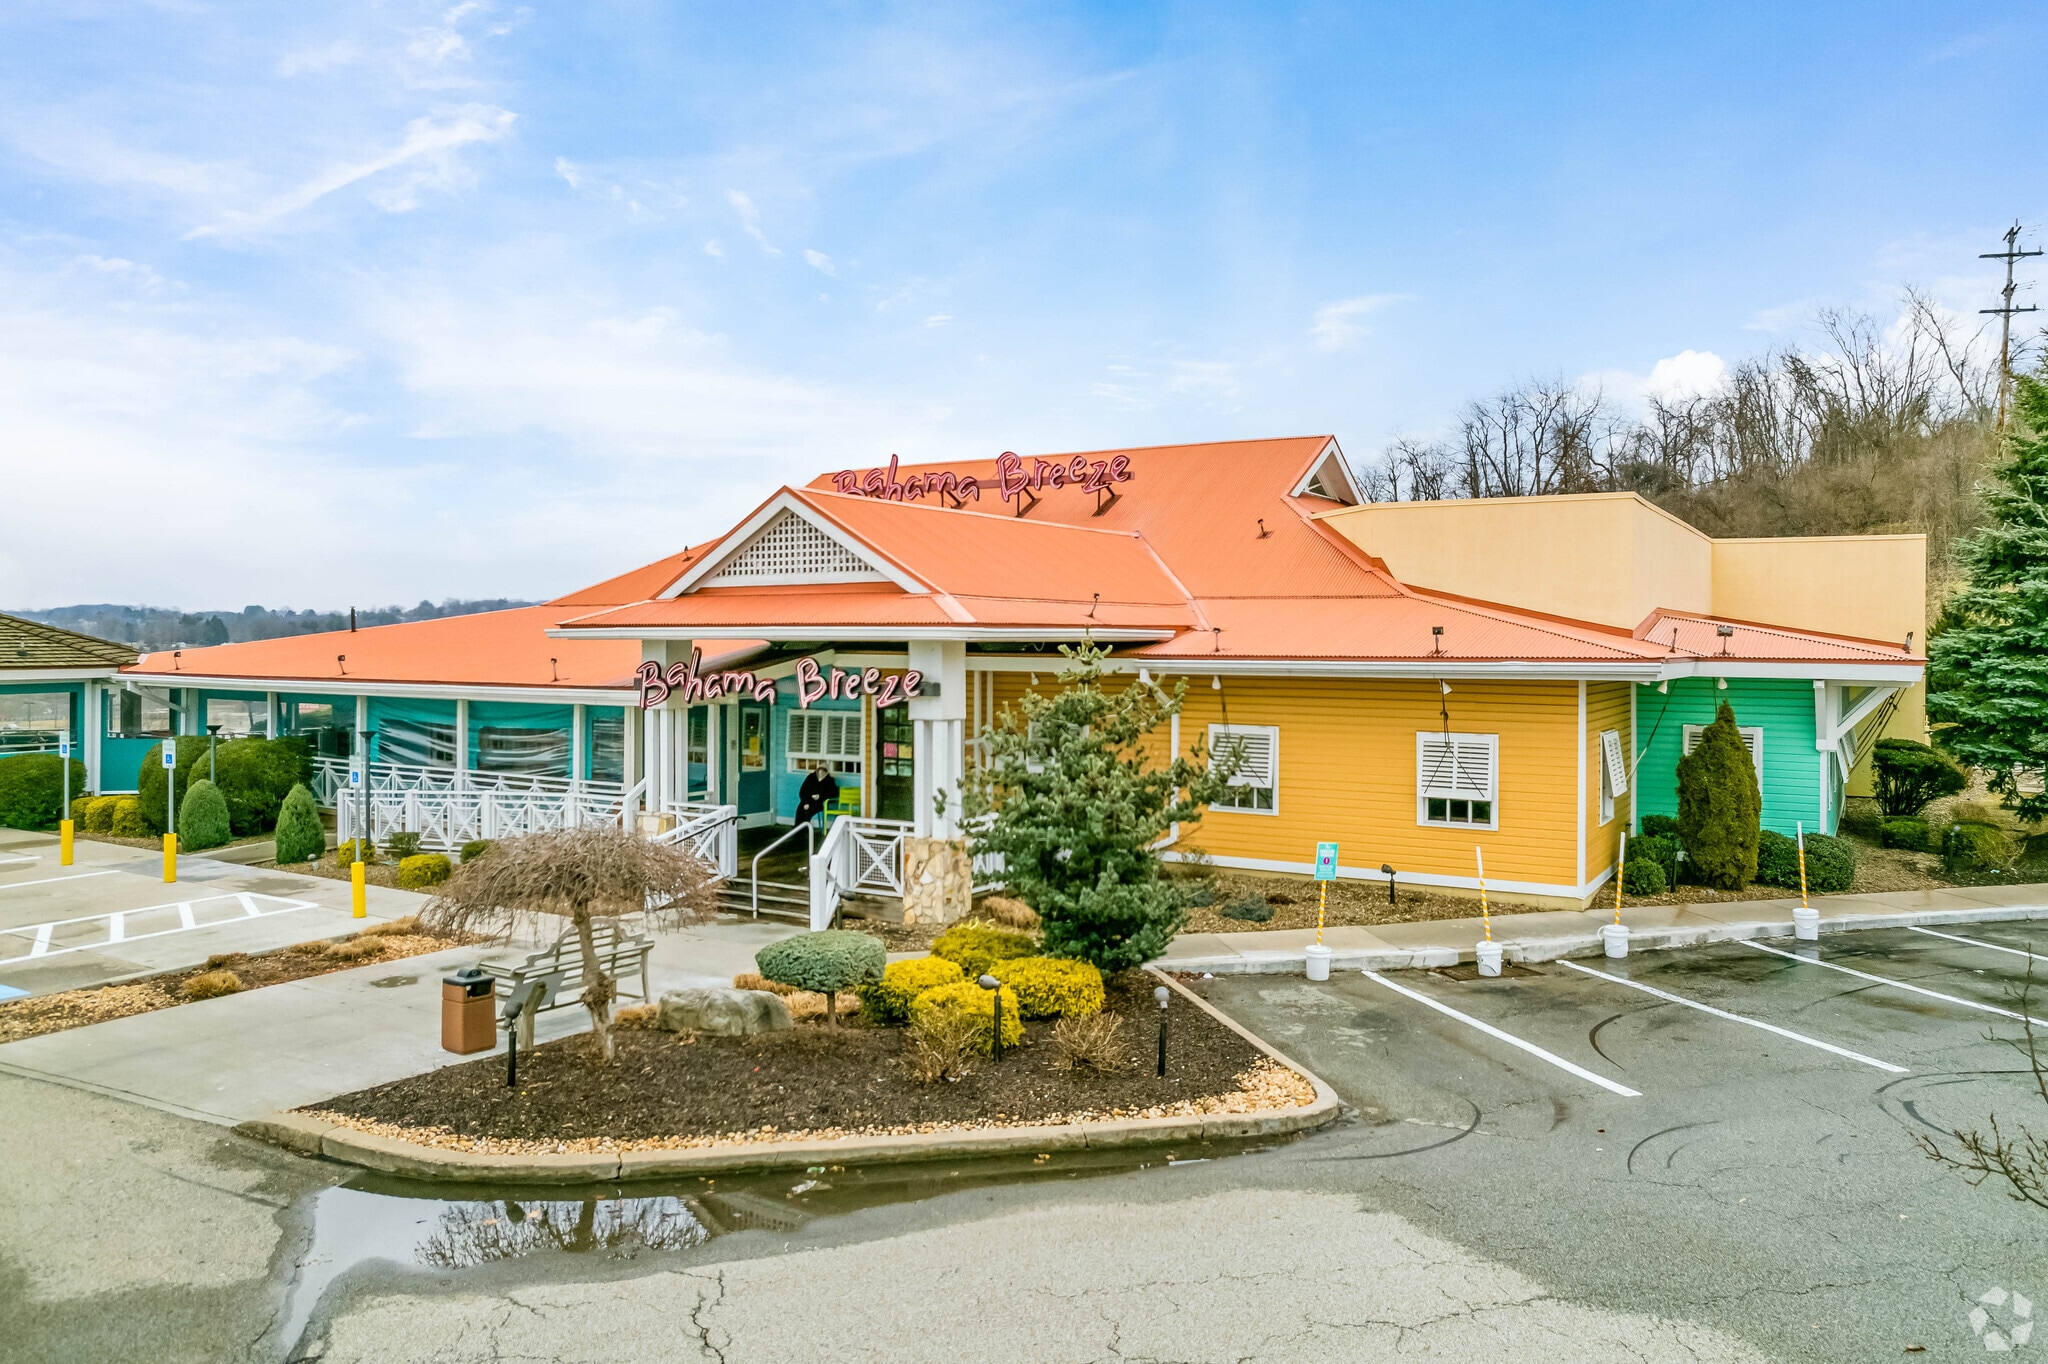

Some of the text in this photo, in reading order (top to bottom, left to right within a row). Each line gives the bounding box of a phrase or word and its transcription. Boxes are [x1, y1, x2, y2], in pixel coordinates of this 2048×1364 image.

[832, 451, 1130, 503] Bahama Breeze
[636, 646, 922, 710] Bahama Breeze
